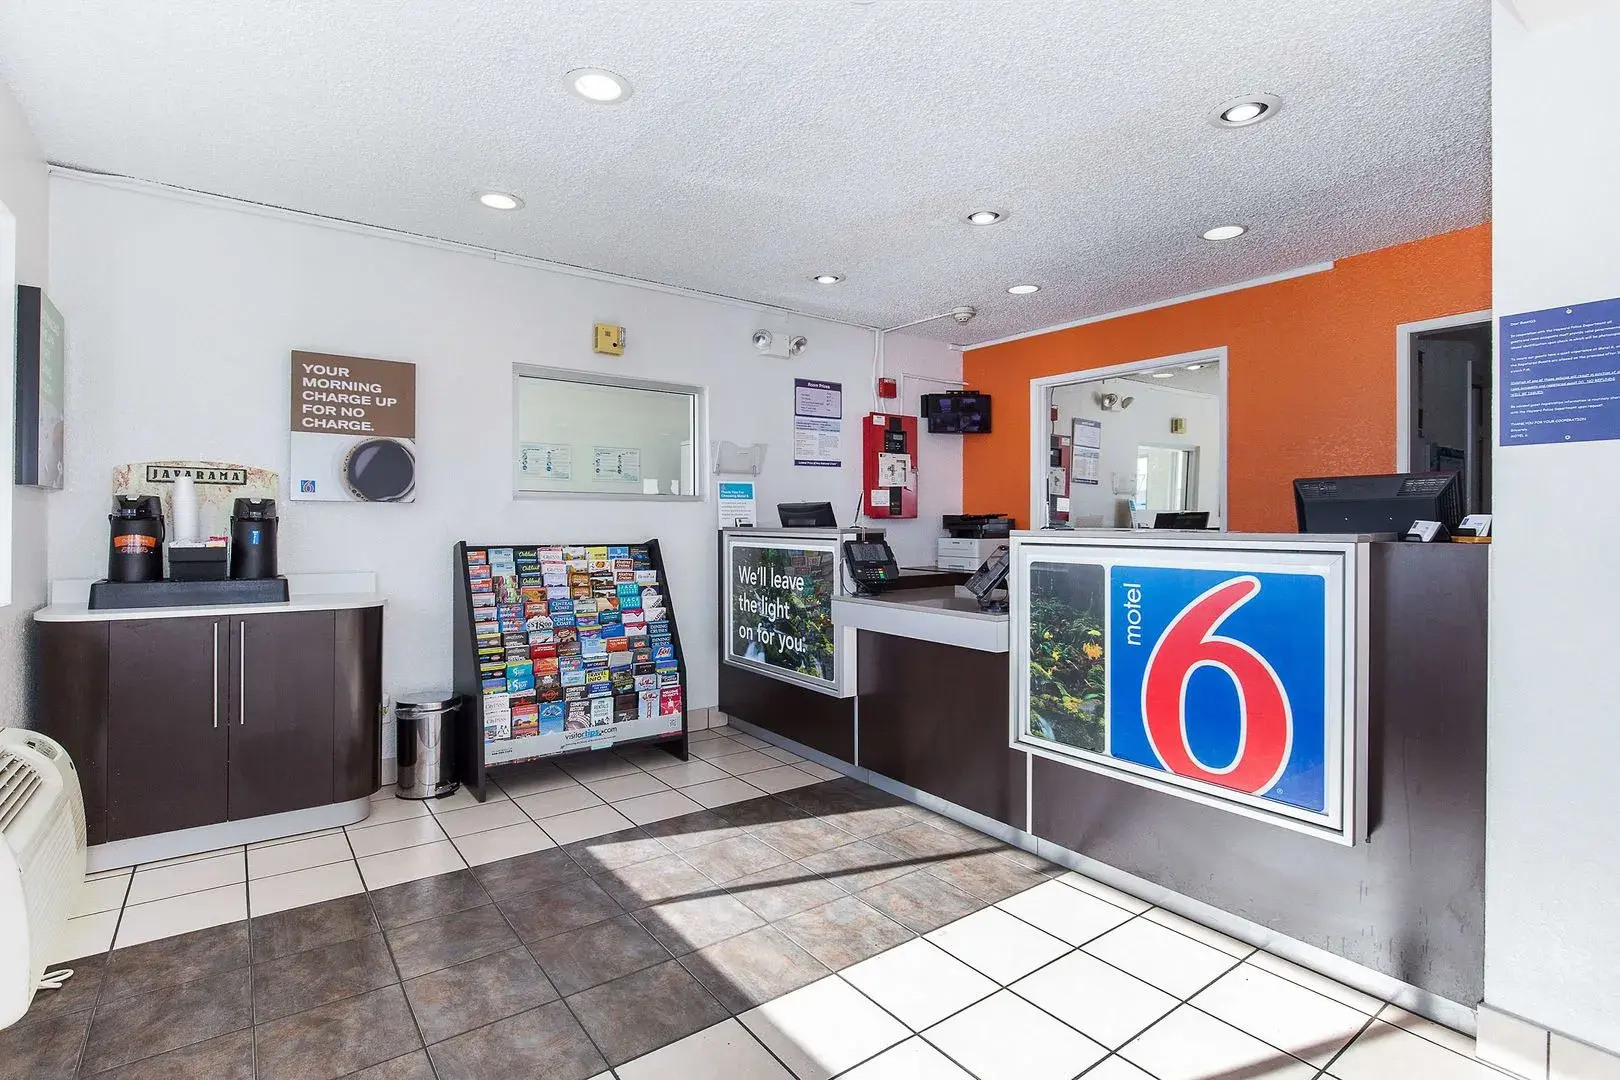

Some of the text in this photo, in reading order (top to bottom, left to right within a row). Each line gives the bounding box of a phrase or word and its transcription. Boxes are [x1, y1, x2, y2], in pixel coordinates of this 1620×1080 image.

[302, 363, 350, 377] YOUR
[302, 377, 382, 393] MORNING
[302, 390, 397, 407] CHARGE UP
[302, 404, 365, 418] FOR NO
[302, 418, 374, 431] CHARGE.
[152, 469, 240, 481] JAVARAMA
[738, 566, 804, 591] We'll leave
[739, 592, 790, 622] the light
[739, 622, 806, 654] on for you.
[1123, 575, 1294, 796] motel 6
[565, 726, 618, 740] visitortips.com
